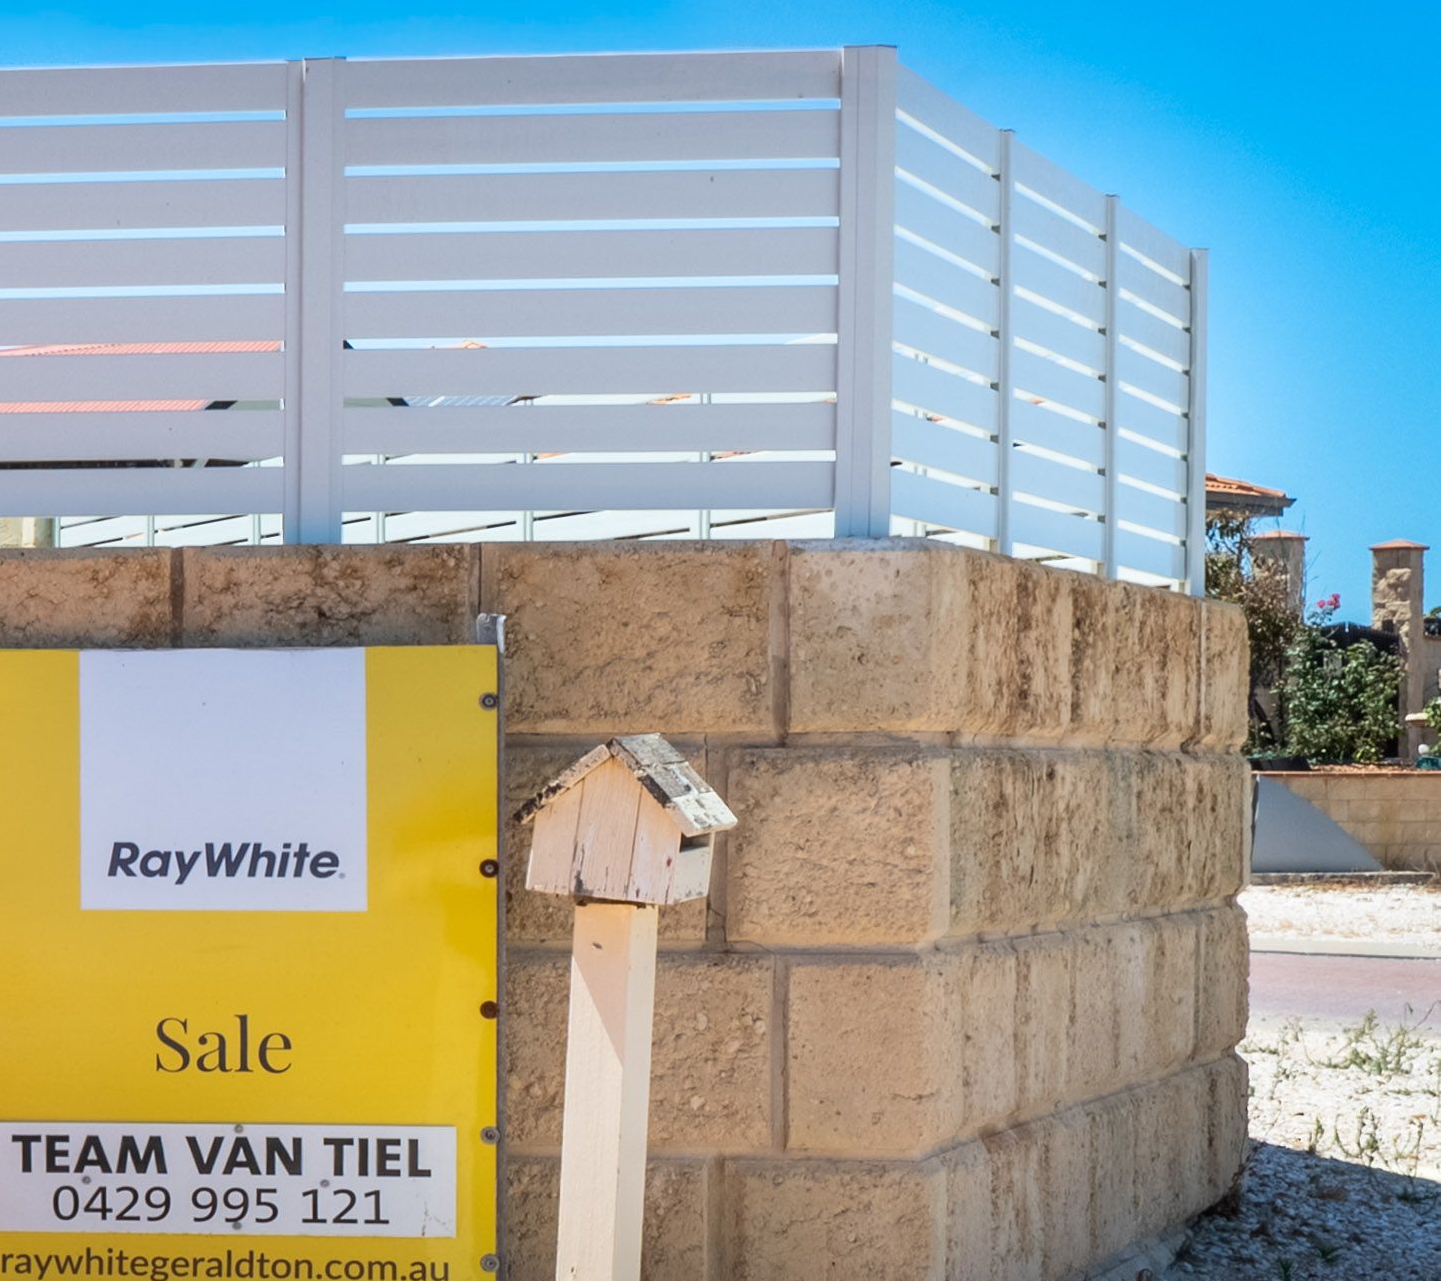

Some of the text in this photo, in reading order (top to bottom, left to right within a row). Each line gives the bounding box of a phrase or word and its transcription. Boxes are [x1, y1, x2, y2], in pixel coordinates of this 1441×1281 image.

[155, 1014, 293, 1074] Sale
[11, 1134, 433, 1178] TEAM VAN TIEL
[52, 1185, 390, 1225] 0429 995 121
